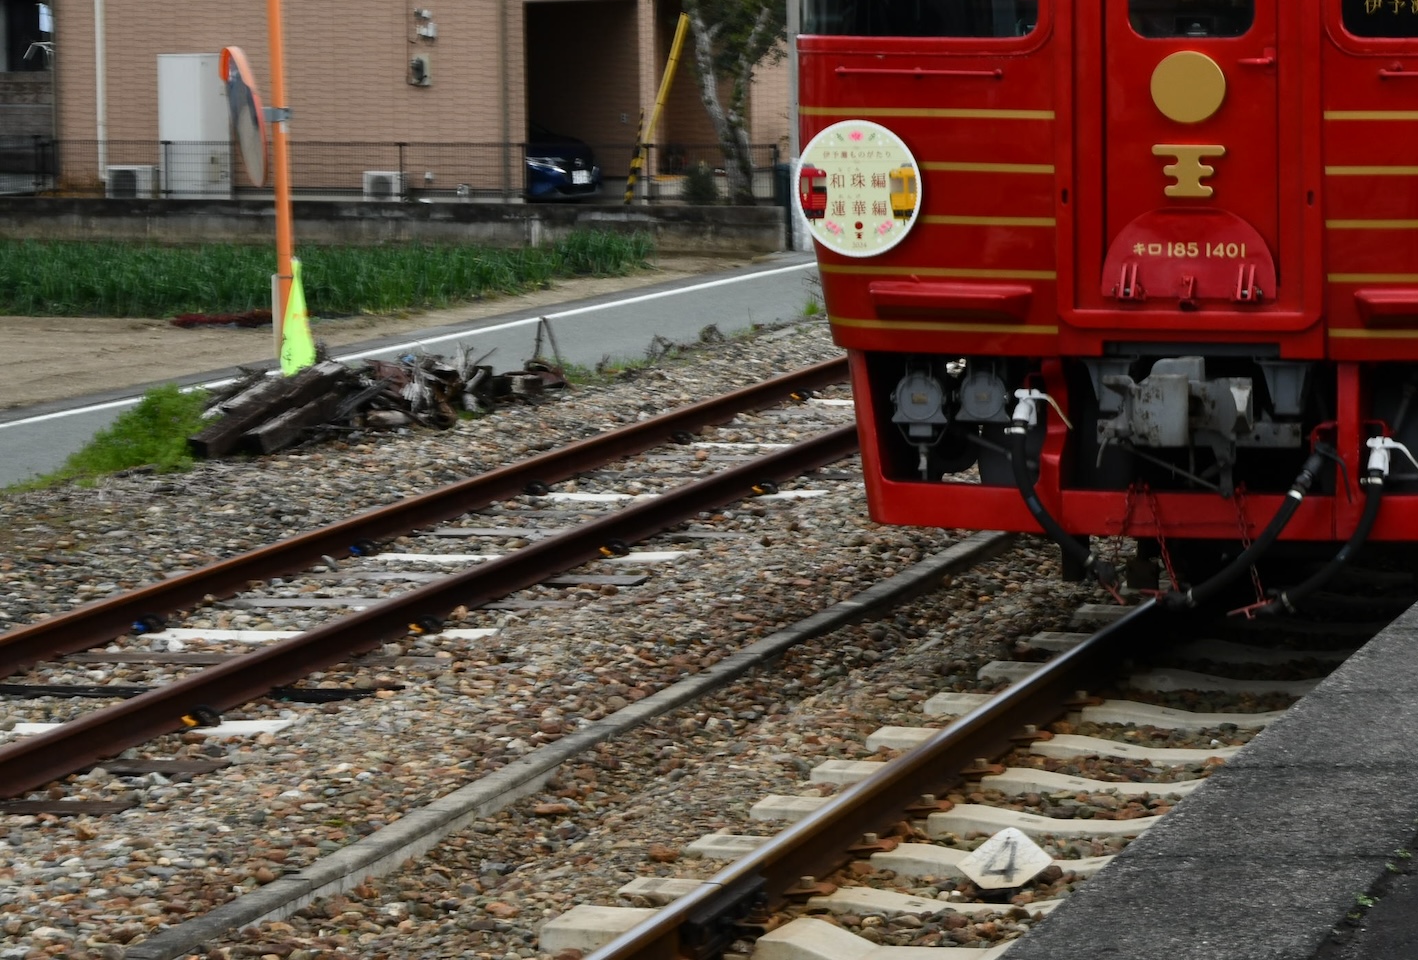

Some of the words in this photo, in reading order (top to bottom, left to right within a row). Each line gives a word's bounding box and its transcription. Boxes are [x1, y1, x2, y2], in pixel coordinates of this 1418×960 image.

[830, 172, 886, 189] 和珠編
[830, 200, 887, 216] 蓮華編
[1205, 242, 1246, 258] 1401
[981, 836, 1020, 883] 4
